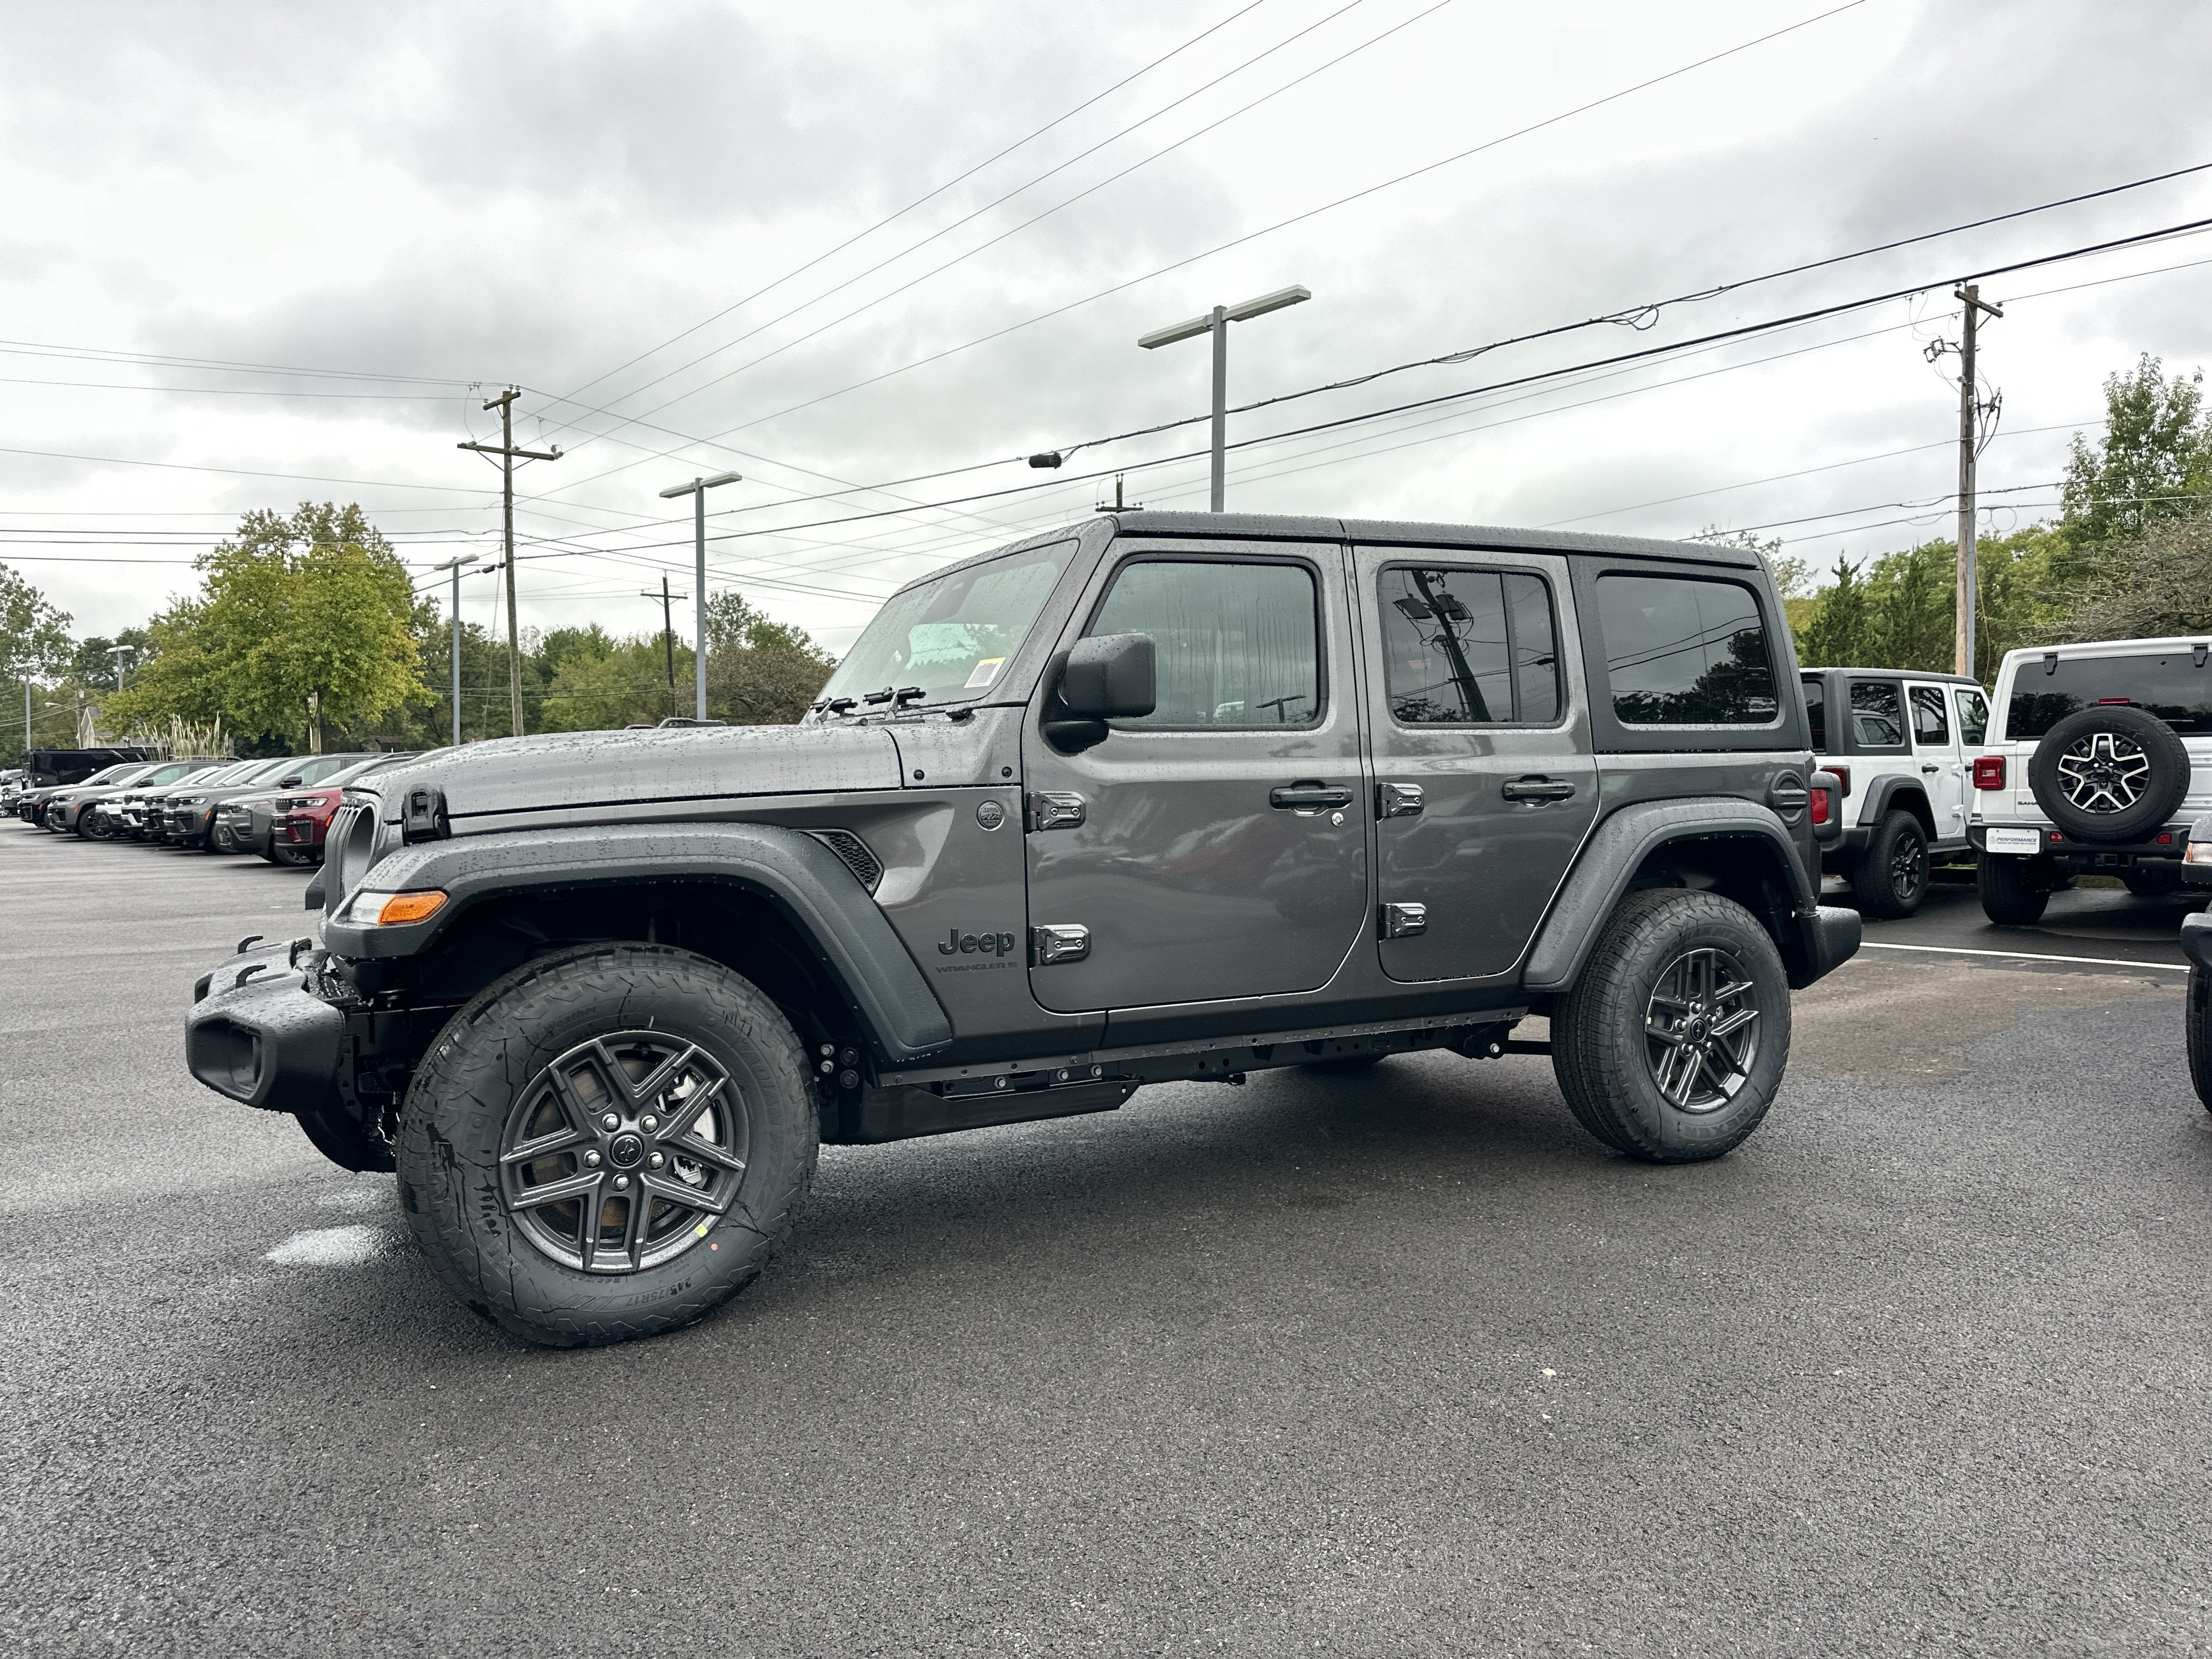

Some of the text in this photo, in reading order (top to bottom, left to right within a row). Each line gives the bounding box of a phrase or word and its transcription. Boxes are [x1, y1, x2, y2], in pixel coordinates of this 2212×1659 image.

[938, 927, 1015, 957] Jeep
[934, 962, 1006, 973] WRANGLER
[625, 1277, 691, 1306] 245/75R17
